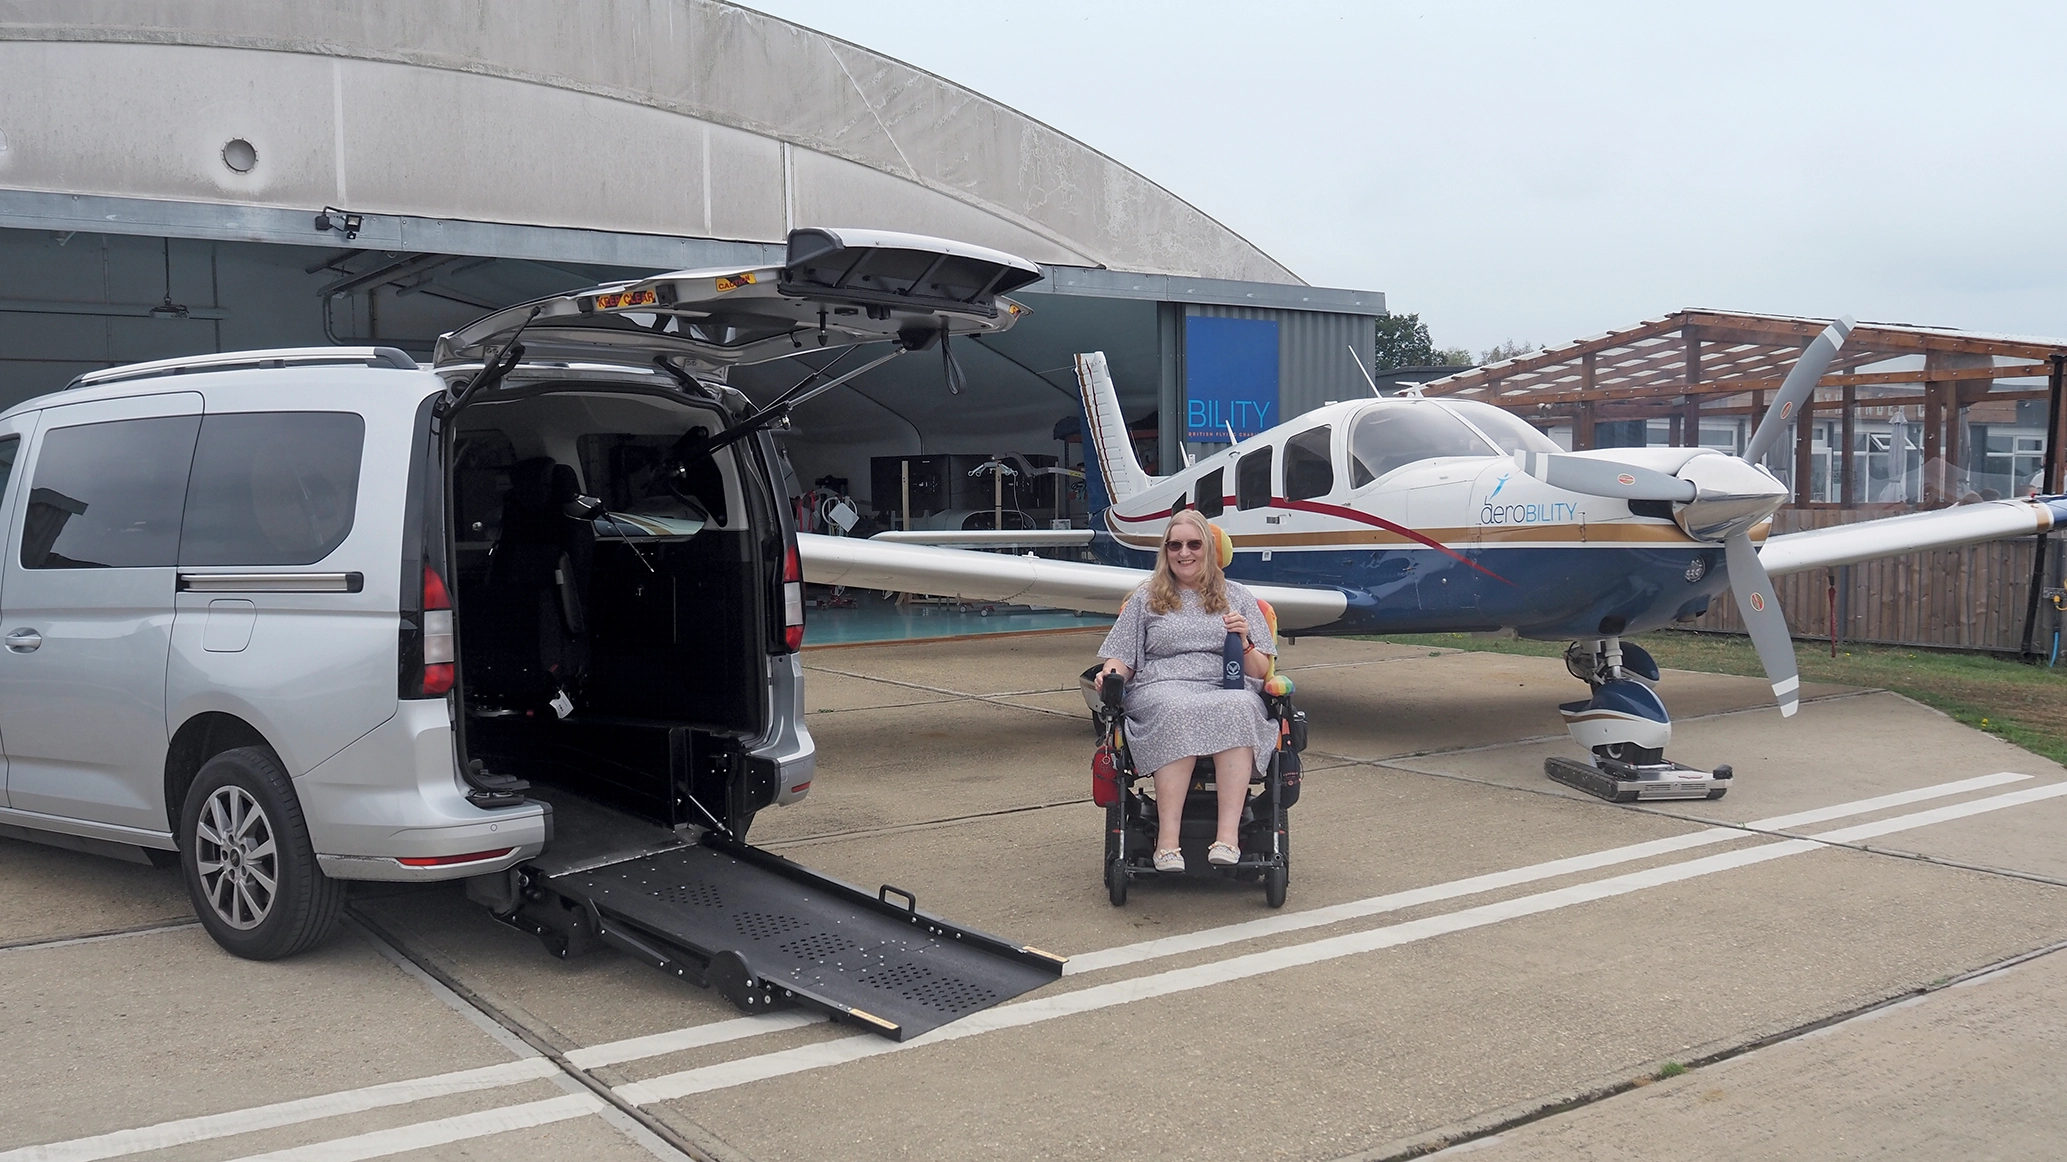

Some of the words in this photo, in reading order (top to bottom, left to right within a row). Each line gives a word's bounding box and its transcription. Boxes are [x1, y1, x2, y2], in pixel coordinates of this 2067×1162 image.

[718, 274, 750, 289] CAUTION
[598, 295, 620, 307] KEEP
[623, 291, 655, 305] CLEAR
[1188, 399, 1270, 429] BILITY
